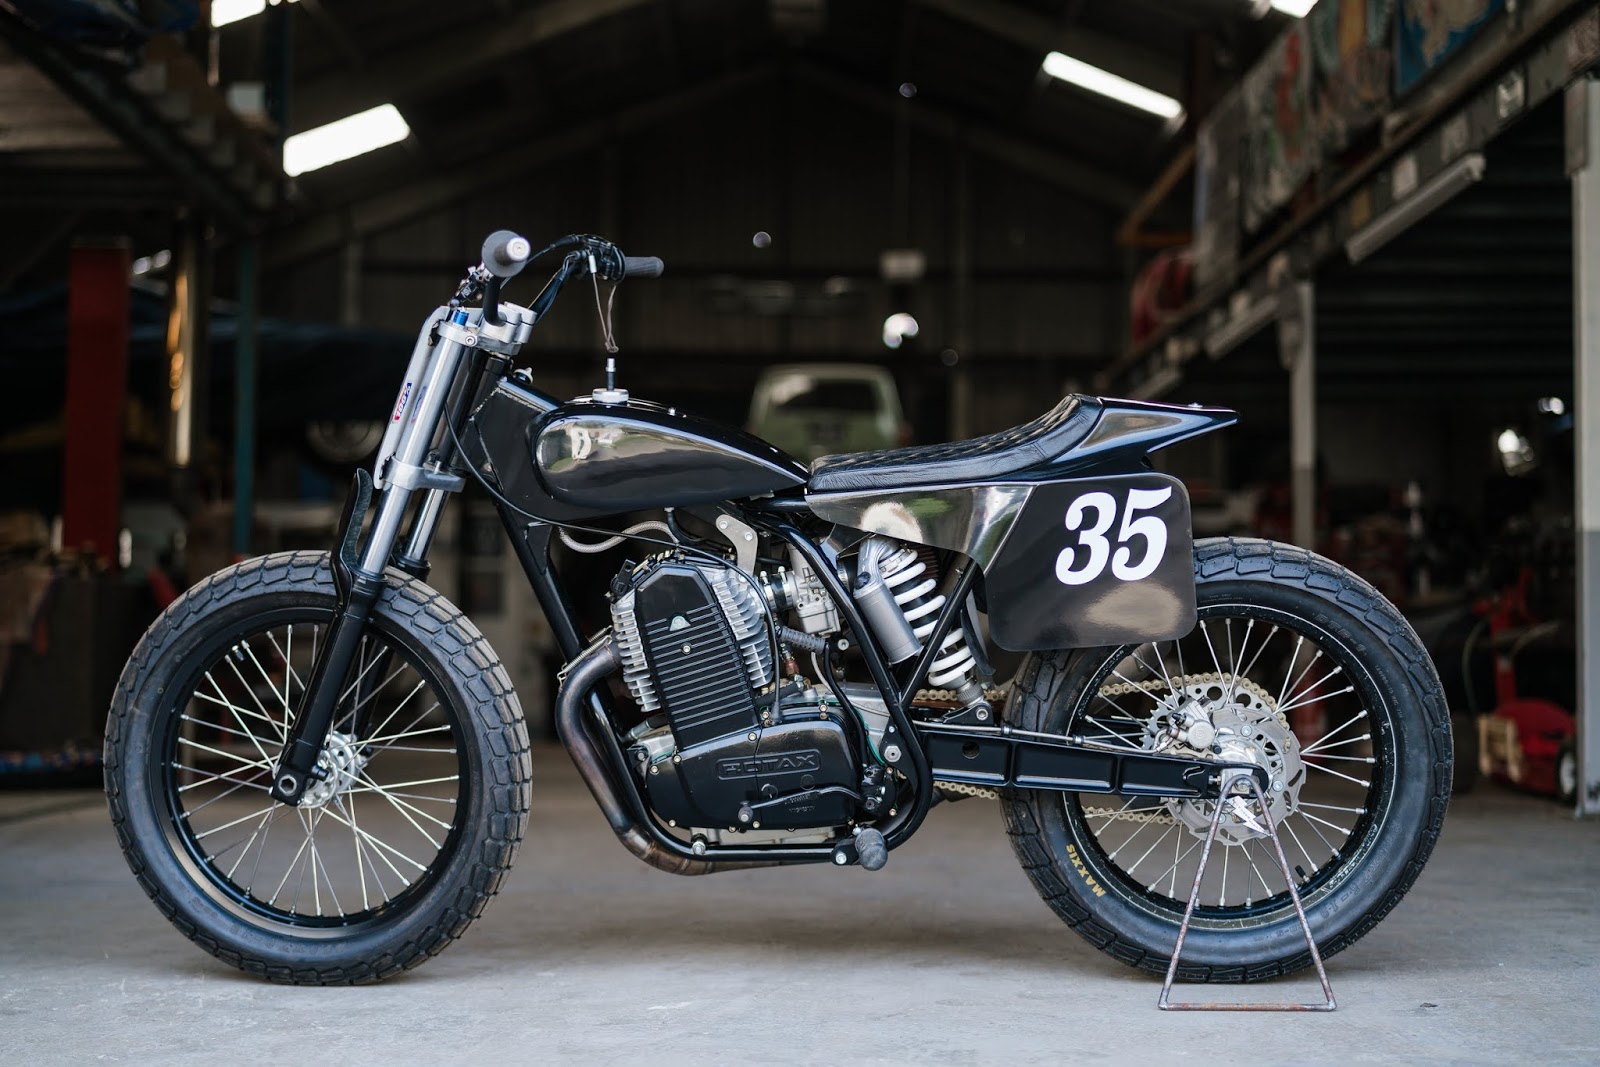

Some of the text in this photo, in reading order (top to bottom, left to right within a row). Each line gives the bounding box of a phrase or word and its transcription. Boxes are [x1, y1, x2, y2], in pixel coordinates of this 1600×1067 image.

[1055, 486, 1172, 585] 35
[721, 754, 816, 776] ROTAX
[1066, 844, 1106, 897] MAXXIS
